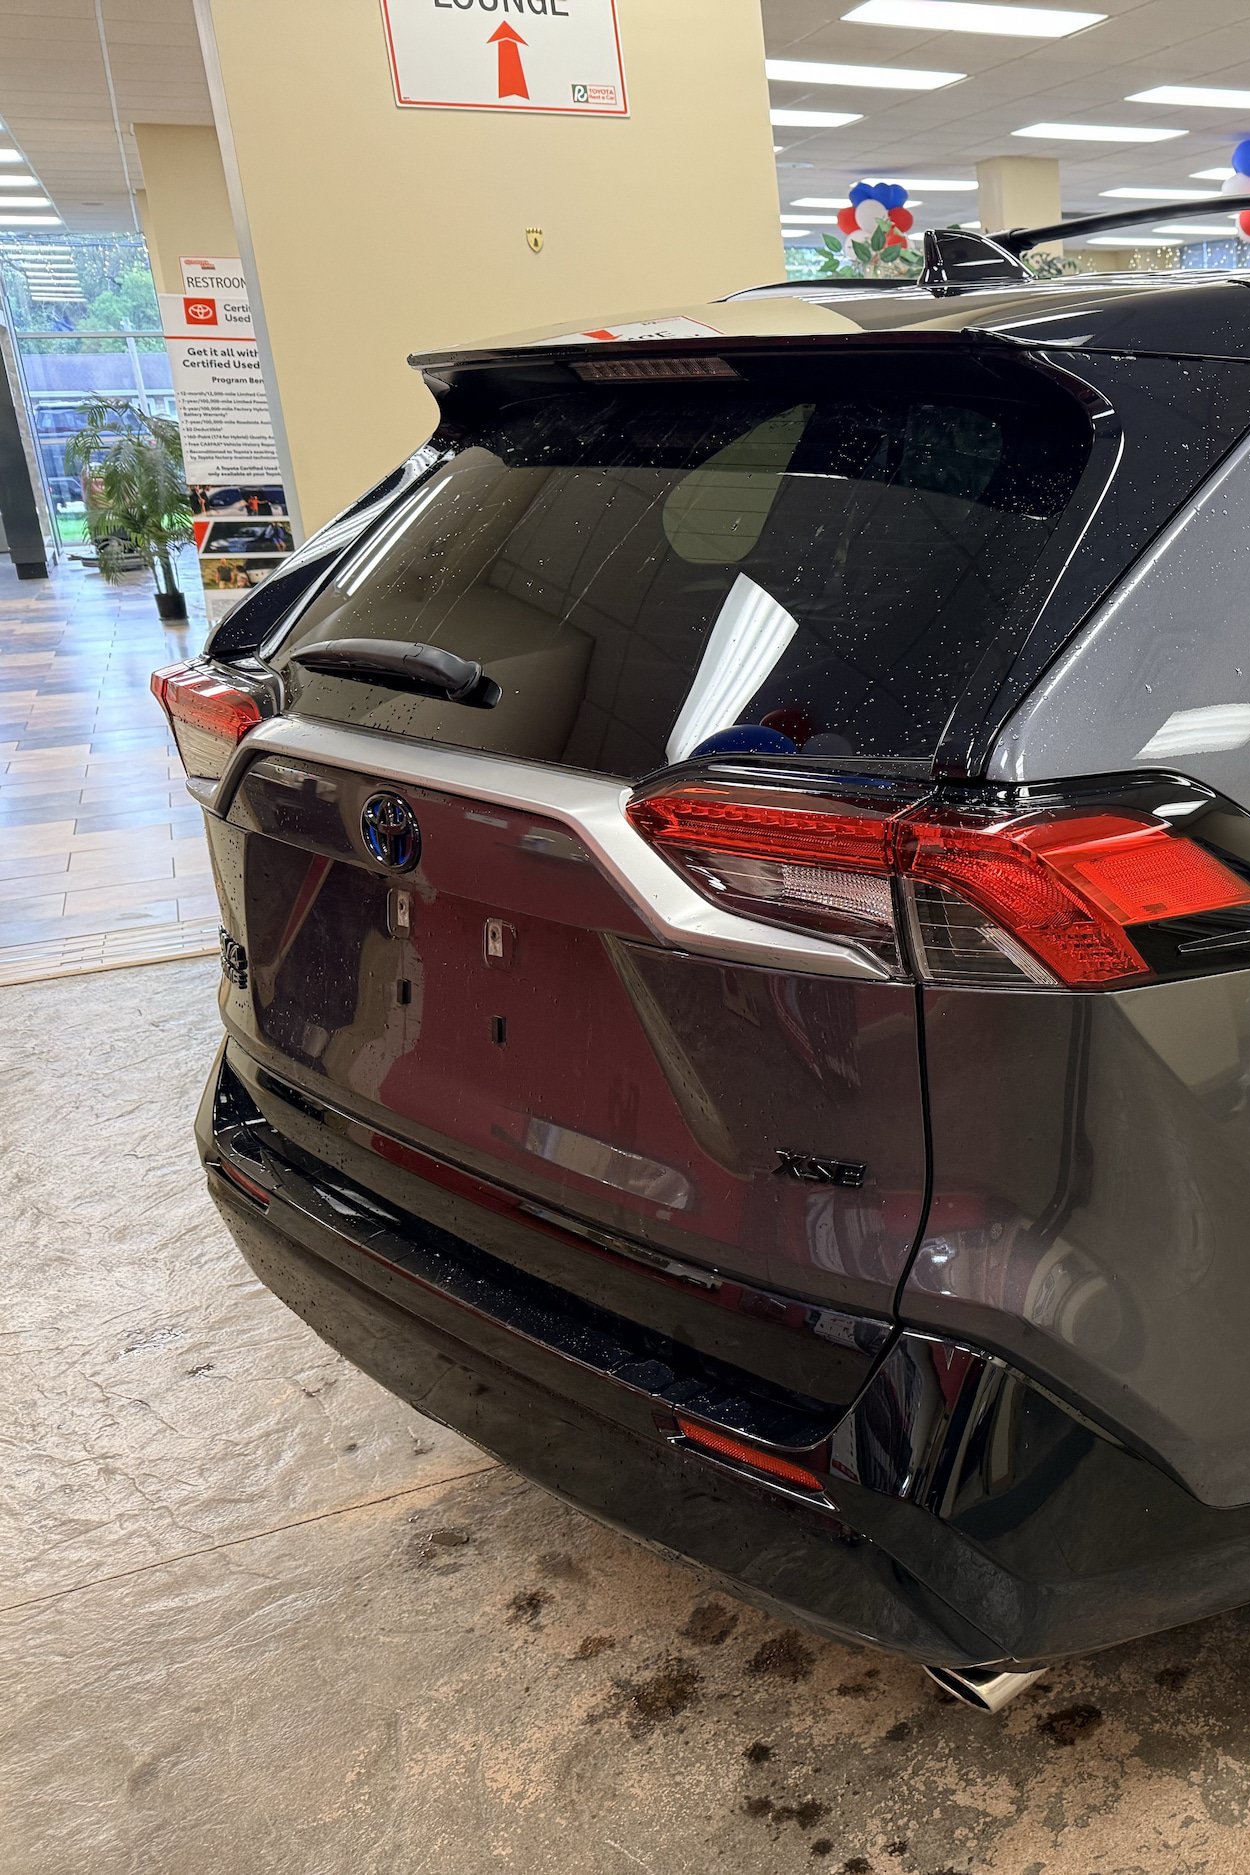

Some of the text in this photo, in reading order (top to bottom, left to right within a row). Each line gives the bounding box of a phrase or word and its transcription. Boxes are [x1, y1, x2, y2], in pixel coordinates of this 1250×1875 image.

[225, 314, 251, 323] Used
[187, 347, 209, 356] Get
[210, 347, 219, 357] it
[220, 348, 235, 357] all
[182, 359, 260, 369] Certified Used
[211, 376, 248, 385] Program
[770, 1148, 868, 1189] XSE
